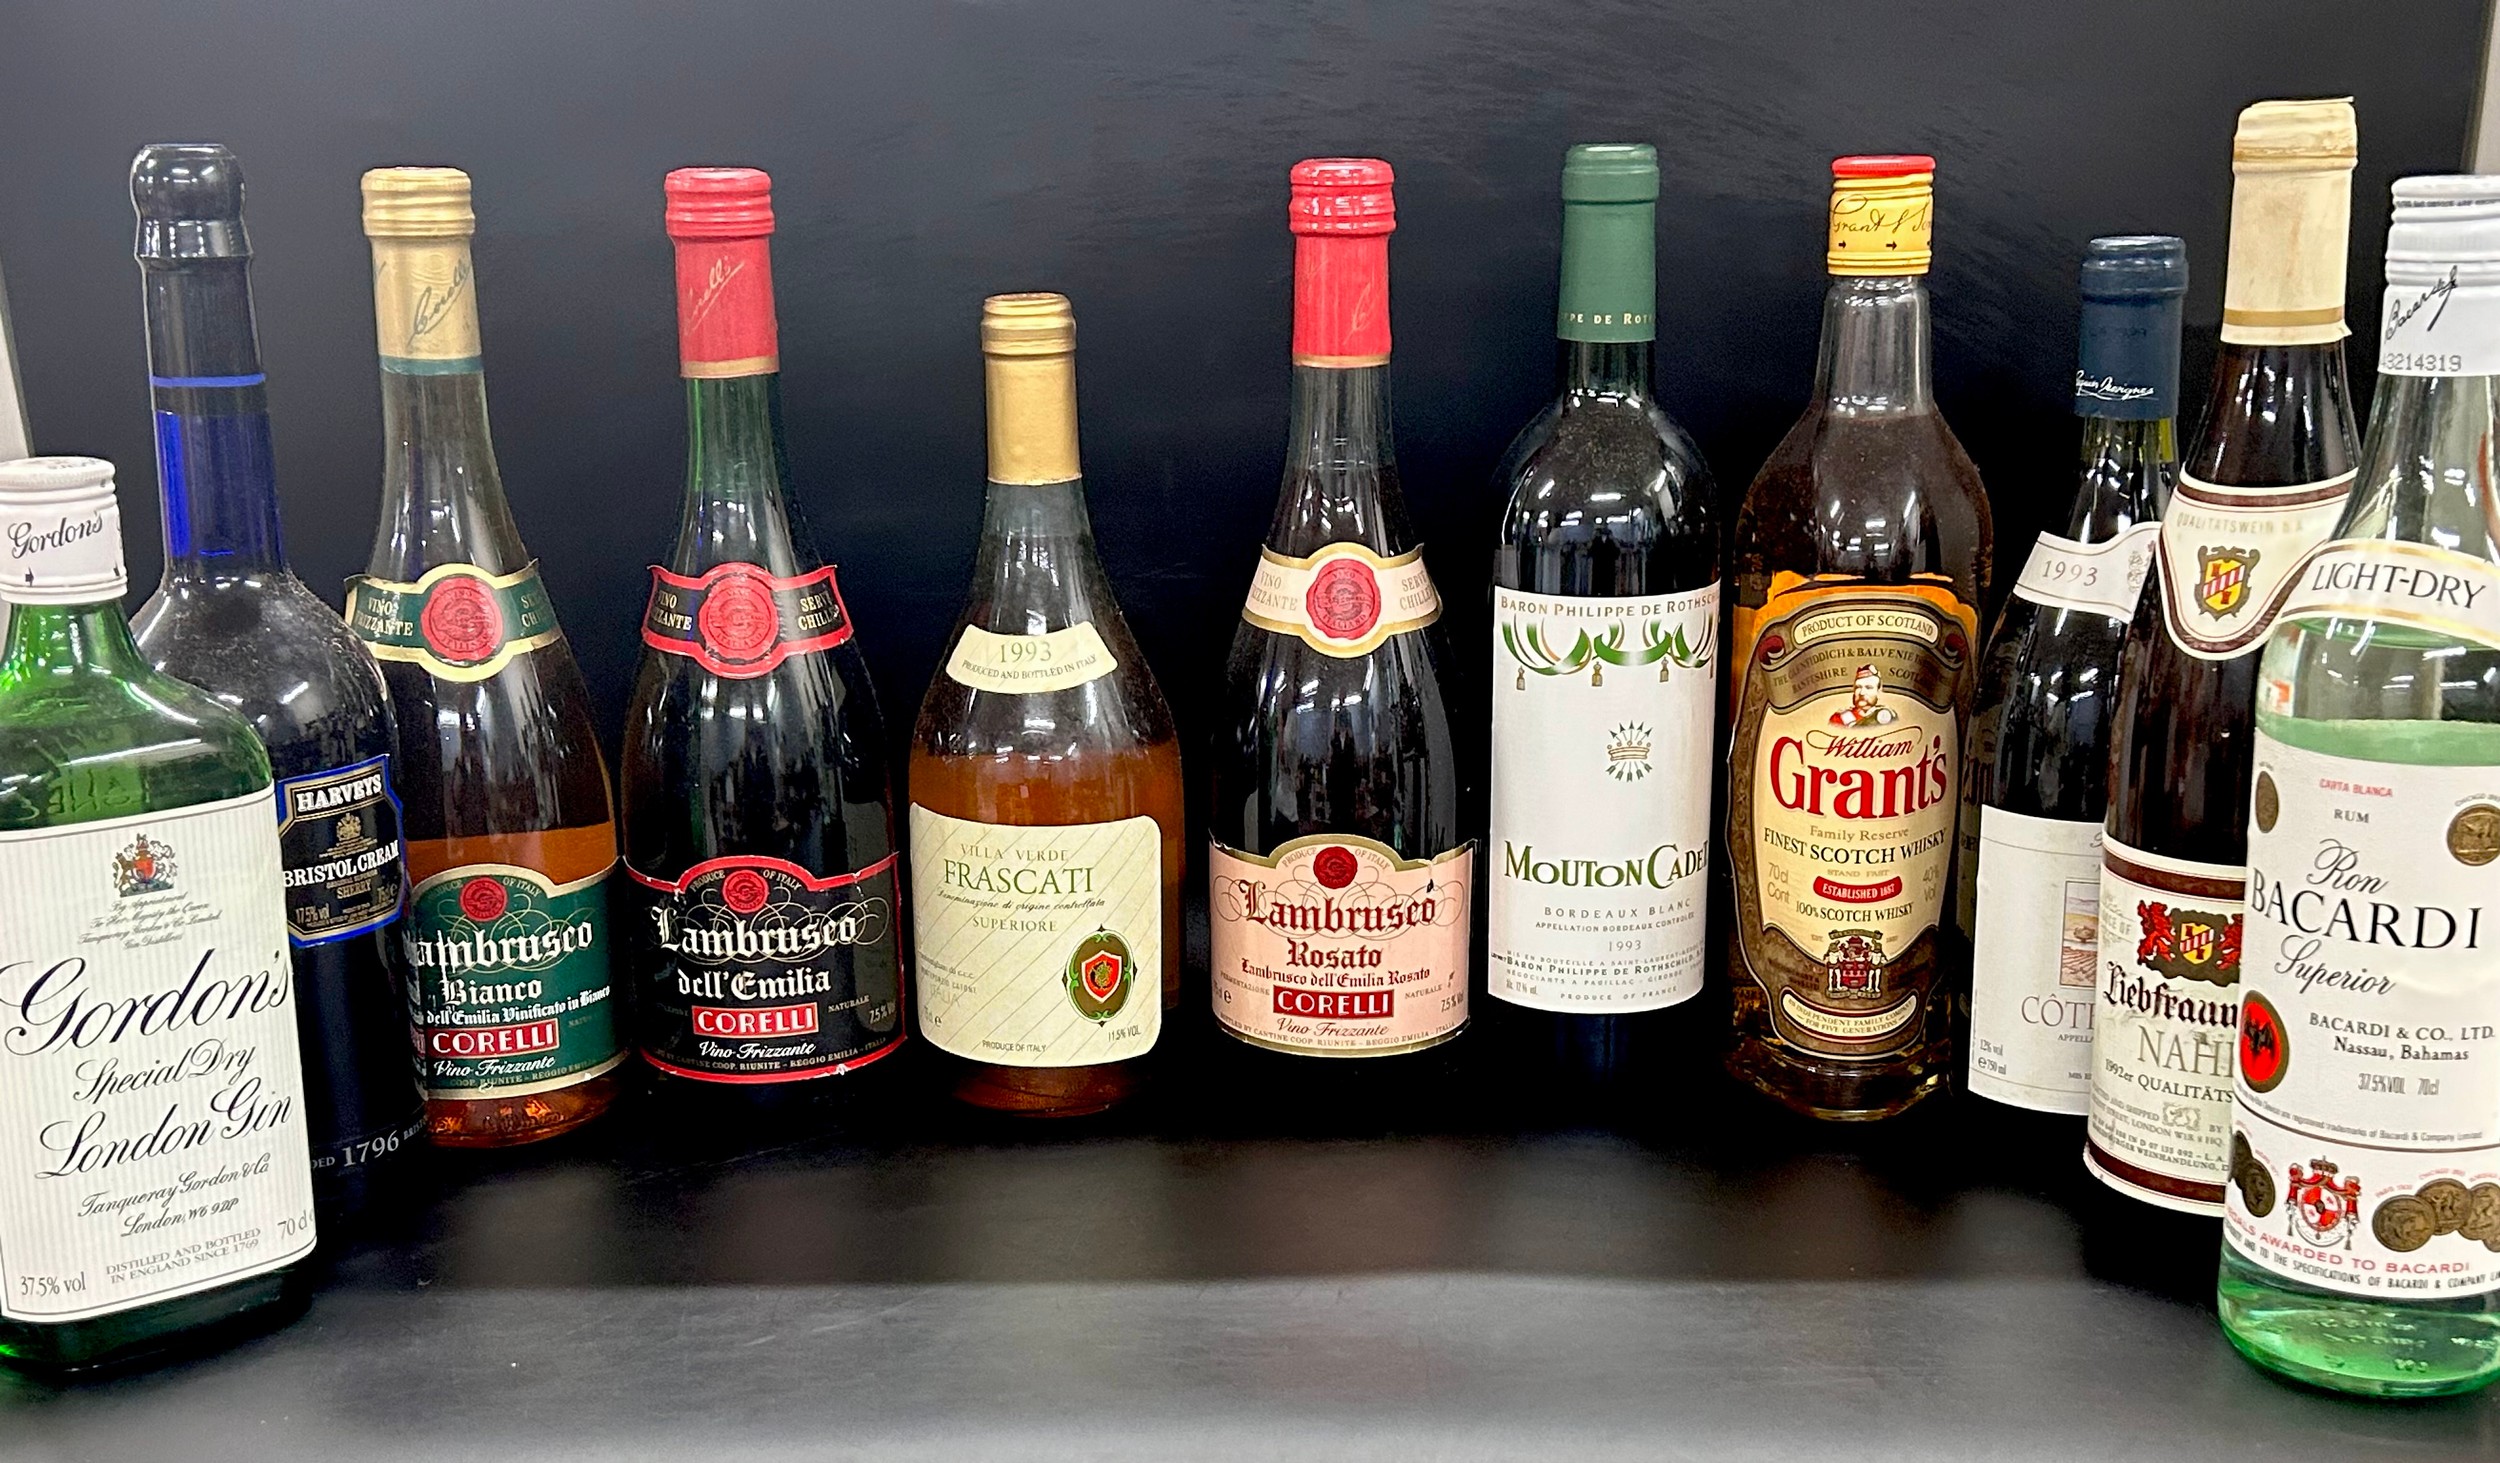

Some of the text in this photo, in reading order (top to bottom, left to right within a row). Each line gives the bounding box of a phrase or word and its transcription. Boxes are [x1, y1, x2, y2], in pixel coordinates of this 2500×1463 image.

[1594, 314, 1612, 325] DE
[8, 510, 103, 559] Gordon's
[1260, 571, 1283, 588] VINO
[2042, 559, 2098, 587] 1993
[2312, 563, 2486, 609] LIGHT-DRY
[367, 596, 393, 615] VINO
[1501, 596, 1662, 617] BARON PHILIPPE DE
[1801, 614, 1934, 638] PRODUCT OF SCOTLAND
[999, 641, 1052, 664] 1993
[1847, 648, 1855, 658] &
[1857, 647, 1913, 662] BALVENIE
[961, 653, 1098, 680] PRODUCED AND BOTTLED IN ITALY
[1820, 733, 1915, 758] William
[1770, 735, 1948, 820] Grant's
[2319, 778, 2394, 798] CARTA BLANCA
[295, 774, 382, 812] HARVEYS
[2334, 808, 2370, 824] RUM
[1810, 825, 1910, 842] Family Reserve
[960, 843, 1069, 862] VILLA VERDE
[1764, 827, 1948, 865] FINEST SCOTCH WHISKY
[282, 857, 357, 888] BRISTOL
[357, 839, 399, 873] CREAM
[1282, 847, 1390, 870] PRODUCE OF ITALY
[2306, 838, 2390, 894] Ron
[690, 870, 802, 891] PRODUCE OF ITALY
[943, 857, 1095, 895] FRASCATI
[1768, 862, 1789, 884] 70cl
[1922, 864, 1941, 882] 40%
[337, 879, 372, 900] SHERRY
[503, 876, 542, 898] OF ITALY
[1767, 884, 1790, 904] Cont
[1822, 883, 1878, 899] ESTABLISHED
[1001, 898, 1051, 912] di origine
[1239, 879, 1436, 932] Lambrusco
[1544, 898, 1691, 919] BORDEAUX BLANC
[1796, 900, 1914, 922] 100% SCOTCH WHISKY
[2251, 867, 2482, 949] BACARDI
[650, 906, 858, 957] Lambrusco
[972, 917, 1058, 932] SUPERIORE
[1535, 921, 1653, 933] APPELLATION BORDEAUX
[416, 920, 594, 970] ambrusco
[1286, 938, 1383, 970] Rosato
[1608, 939, 1642, 952] 1993
[1241, 958, 1307, 985] Lambrusco
[1388, 967, 1430, 986] Rosato
[1507, 956, 1543, 971] BARON
[1549, 964, 1607, 977] PHILIPPE
[1614, 967, 1629, 976] DE
[2274, 934, 2397, 996] Superior
[0, 948, 290, 1057] Gordon's
[441, 978, 543, 1006] Bianco
[1277, 990, 1389, 1015] CORELLI
[1405, 984, 1443, 999] NATURALE
[1560, 986, 1677, 1001] PRODUCE OF FRANCE
[502, 1001, 567, 1024] Vinificato
[567, 996, 580, 1011] in
[828, 995, 870, 1013] NATURALE
[1796, 1004, 1884, 1027] INDEPENDENT FAMILY
[697, 1004, 817, 1035] CORELLI
[1277, 1018, 1389, 1037] Vino Frizzante
[1821, 1018, 1899, 1034] FIVE GENERATIONS
[2309, 1012, 2409, 1039] BACARDI &
[432, 1024, 554, 1054] CORELLI
[699, 1040, 817, 1060] Vino Frizzante
[982, 1039, 1047, 1053] PRODUCE OF ITALY
[1254, 1028, 1288, 1041] CANTINE
[1317, 1038, 1356, 1048] RIUNITE
[1366, 1036, 1400, 1047] REGGIO
[1401, 1029, 1430, 1043] EMILIA
[2333, 1035, 2469, 1061] Nassau, Bahamas
[434, 1055, 556, 1077] Vino Frizzante
[740, 1047, 858, 1071] RIUNITE REGGIO EMILIA
[73, 1038, 257, 1105] Special Dry
[2138, 1073, 2233, 1104] QUALITÄTS
[34, 1077, 292, 1180] London Gin
[2132, 1119, 2171, 1137] LONDON
[341, 1129, 399, 1168] 1796
[78, 1164, 240, 1217] Tanqueray Gordon
[277, 1218, 296, 1240] 70
[106, 1227, 262, 1276] DISTILLED AND BOTTLED
[110, 1238, 259, 1285] IN ENGLAND SINCE 1769
[2260, 1232, 2470, 1274] AWARDED TO BACARDI
[20, 1271, 87, 1298] 37.5% vol
[2293, 1259, 2361, 1285] SPECIFICATIONS
[2368, 1276, 2382, 1287] OF
[2387, 1277, 2428, 1290] BACARDI
